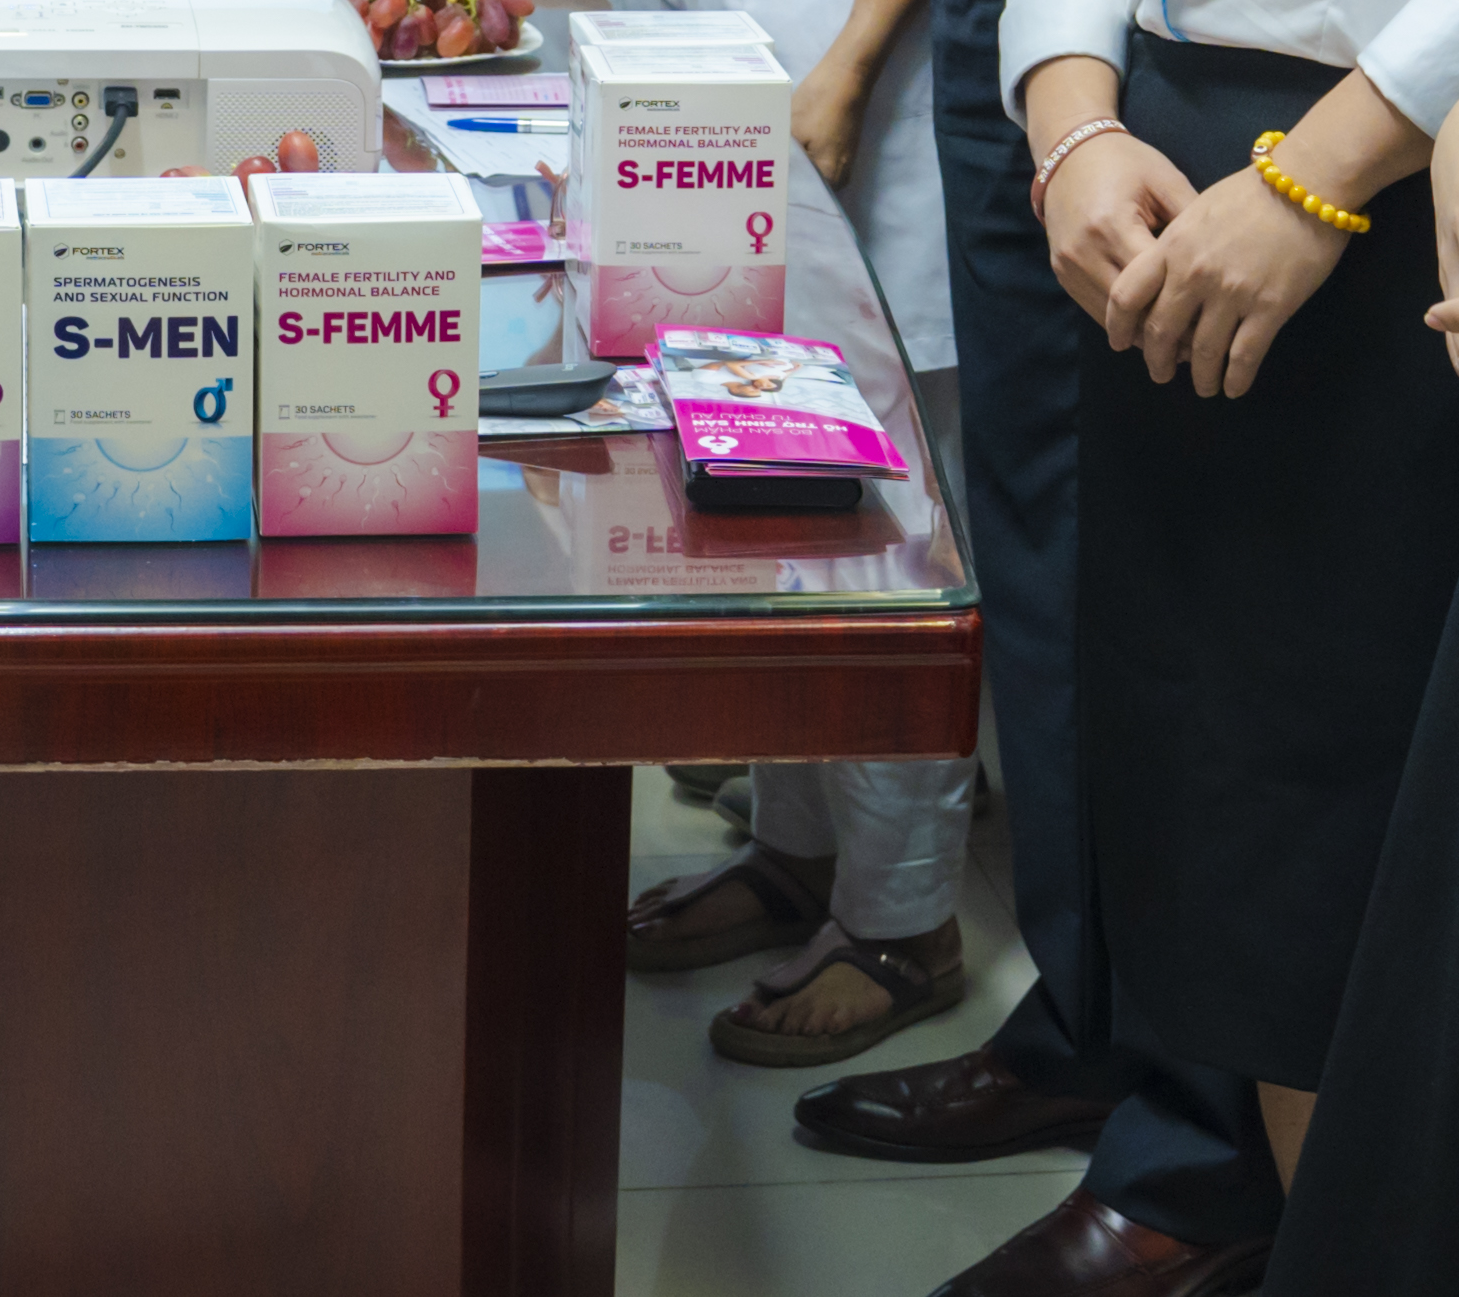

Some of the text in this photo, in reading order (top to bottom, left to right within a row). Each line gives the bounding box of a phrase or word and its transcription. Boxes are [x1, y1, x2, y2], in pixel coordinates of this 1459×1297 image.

[634, 100, 681, 108] FORTEX
[618, 125, 772, 135] FEMALE FERTILITY AND
[618, 138, 758, 148] HORMONAL BALANCE
[617, 159, 775, 190] S-FEMME
[297, 242, 350, 251] FORTEX
[630, 242, 682, 250] 30 SACHETS
[72, 247, 125, 256] FORTEX
[53, 276, 201, 287] SPERMATOGENESIS
[279, 270, 456, 283] FEMALE FERTILITY AND
[53, 291, 229, 302] AND SEXUAL FUNCTION
[279, 286, 440, 298] HORMONAL BALANCE
[278, 309, 461, 345] S-FEMME
[53, 315, 239, 360] S-MEN
[70, 410, 131, 419] 30 SACHETS
[295, 405, 356, 414] 30 SACHETS
